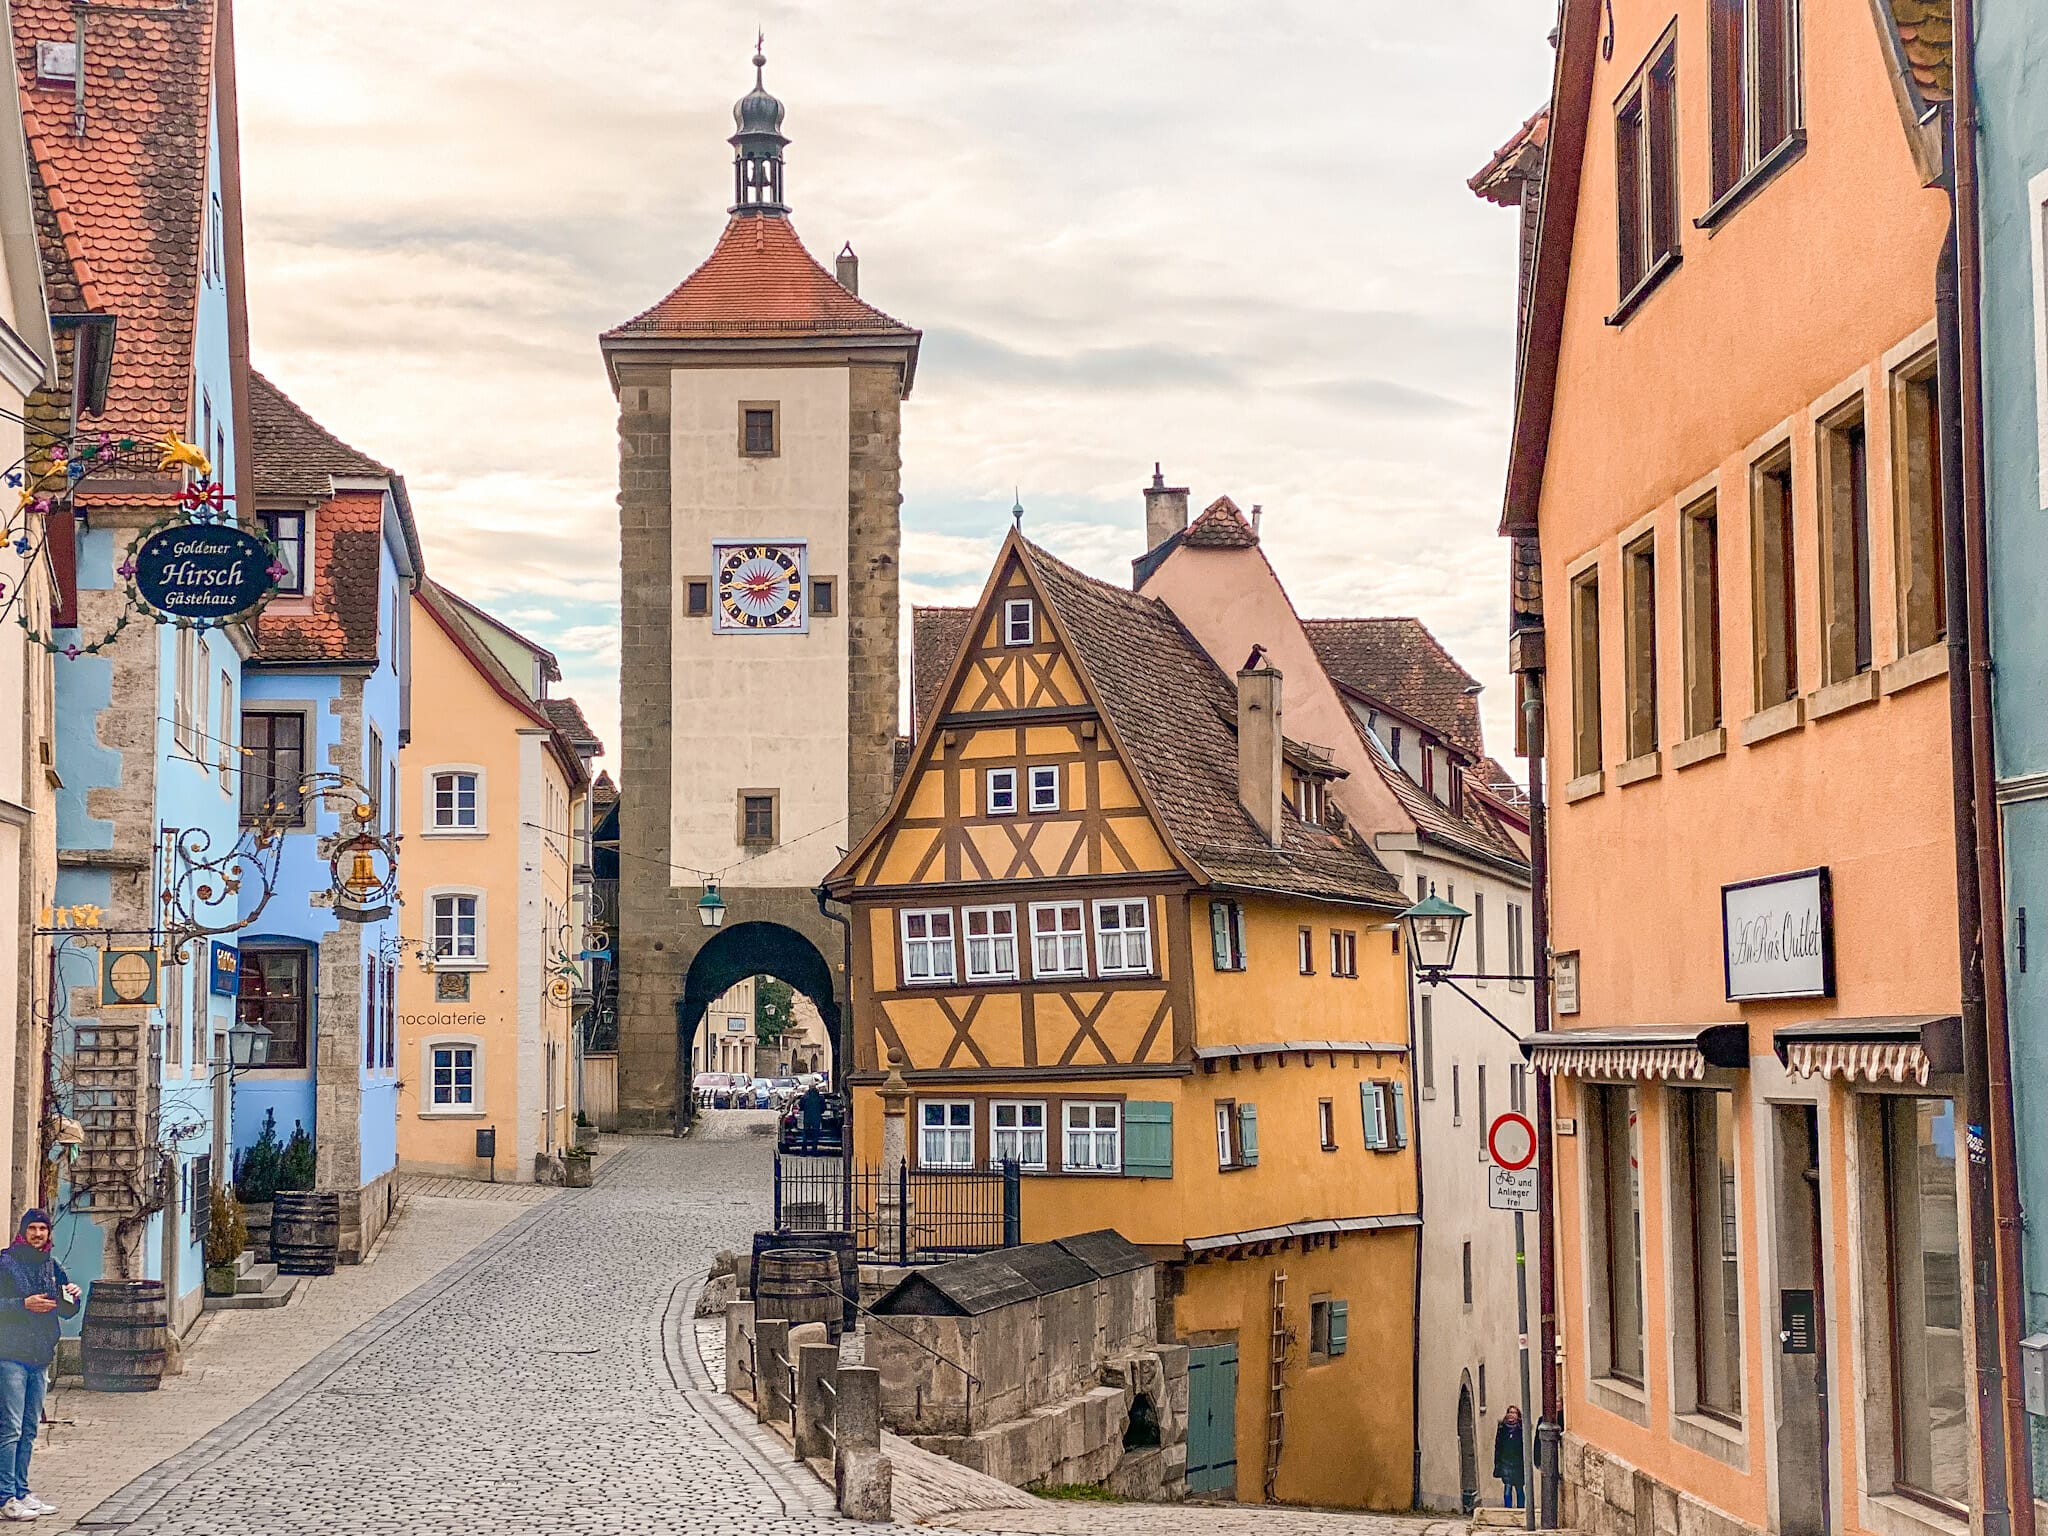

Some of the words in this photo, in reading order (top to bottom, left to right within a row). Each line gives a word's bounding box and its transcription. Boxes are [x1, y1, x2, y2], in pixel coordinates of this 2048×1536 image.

[173, 540, 231, 558] Goldener
[159, 560, 244, 586] Hirsch
[165, 590, 237, 609] Gästehaus
[1782, 908, 1820, 962] Outlet
[1518, 1179, 1532, 1187] und
[1497, 1187, 1530, 1198] Anlieger
[1507, 1198, 1521, 1207] frei
